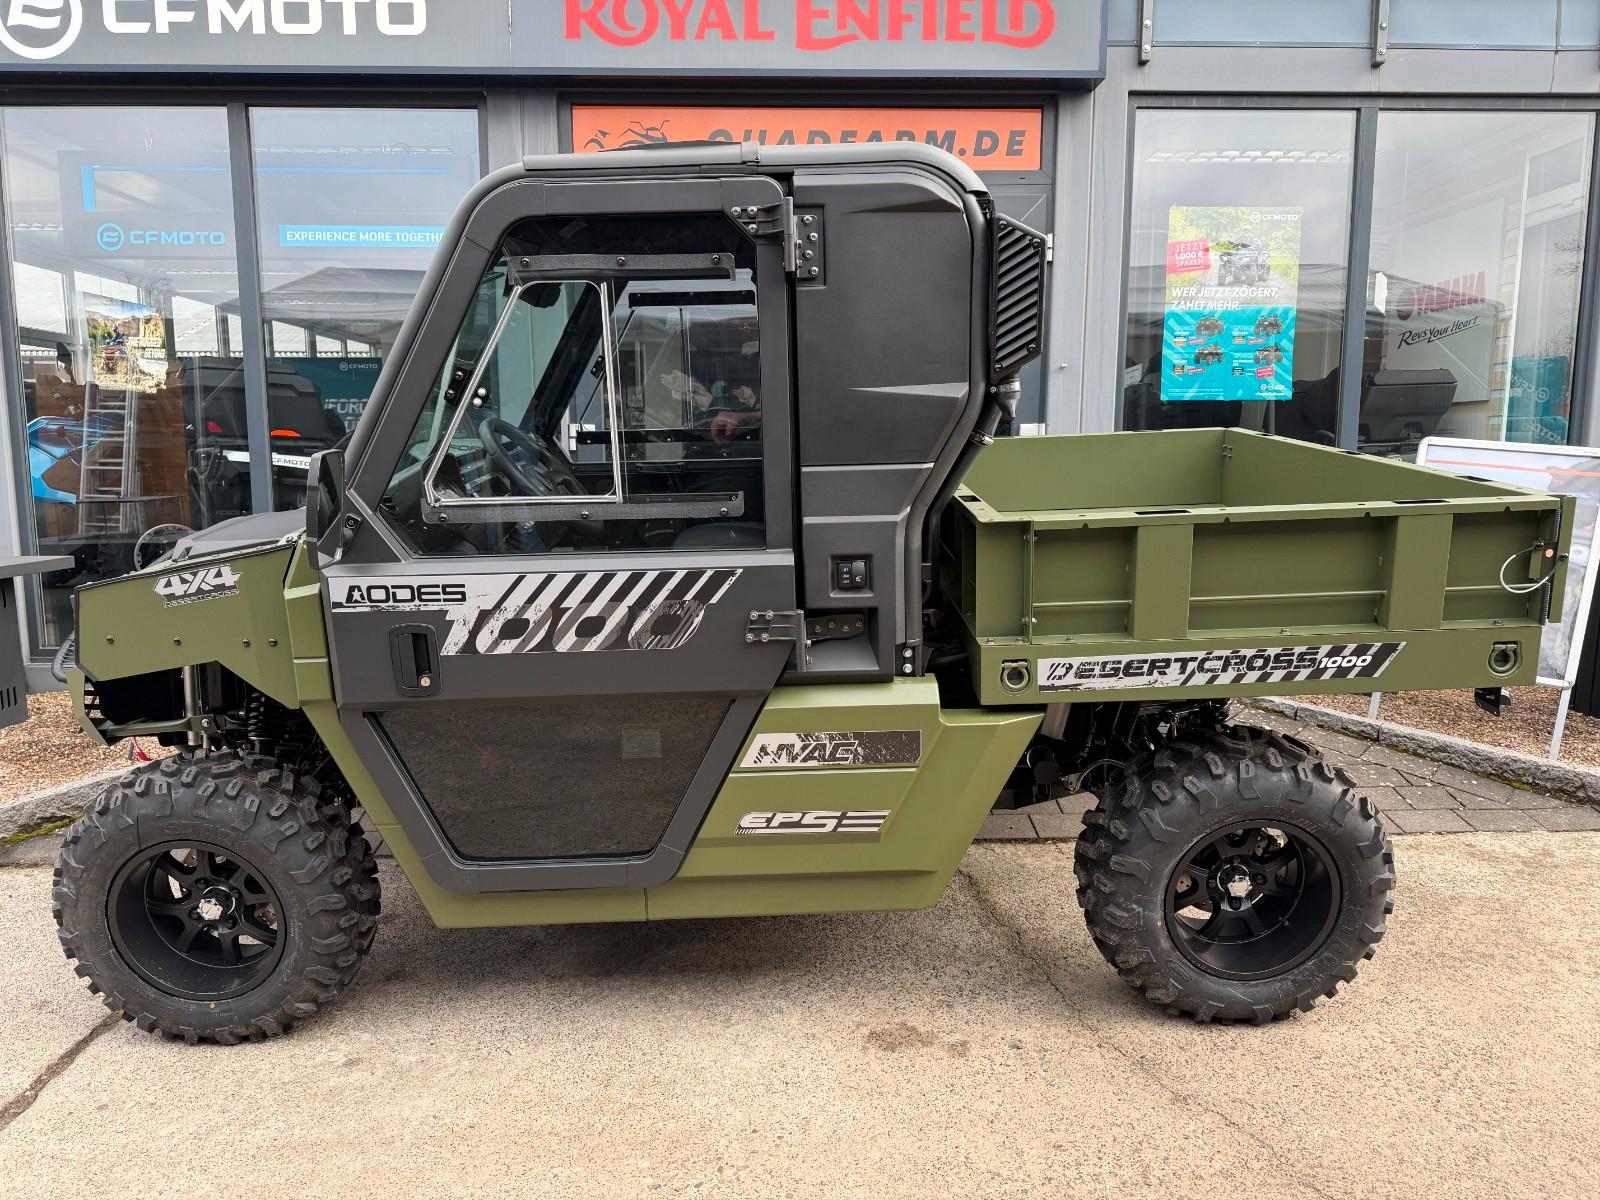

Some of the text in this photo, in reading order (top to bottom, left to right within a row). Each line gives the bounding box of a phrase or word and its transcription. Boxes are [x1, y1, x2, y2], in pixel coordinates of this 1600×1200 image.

[102, 0, 427, 36] CFMOTO
[564, 0, 1057, 50] ROYAL ENFIELD
[1262, 213, 1299, 221] CFMOTO
[129, 230, 225, 245] CFMOTO
[286, 231, 356, 242] EXPERIENCE
[359, 232, 392, 242] MORE
[1175, 242, 1203, 252] JETZT
[1175, 259, 1204, 268] SPAREN
[1171, 284, 1278, 298] WER JETZT ZÖGERT,
[1171, 300, 1241, 311] ZAHLT MEHR.
[1397, 315, 1478, 350] Revs Your Heart
[346, 583, 467, 604] AODES
[1047, 650, 1372, 681] DESERTCROSS 1000
